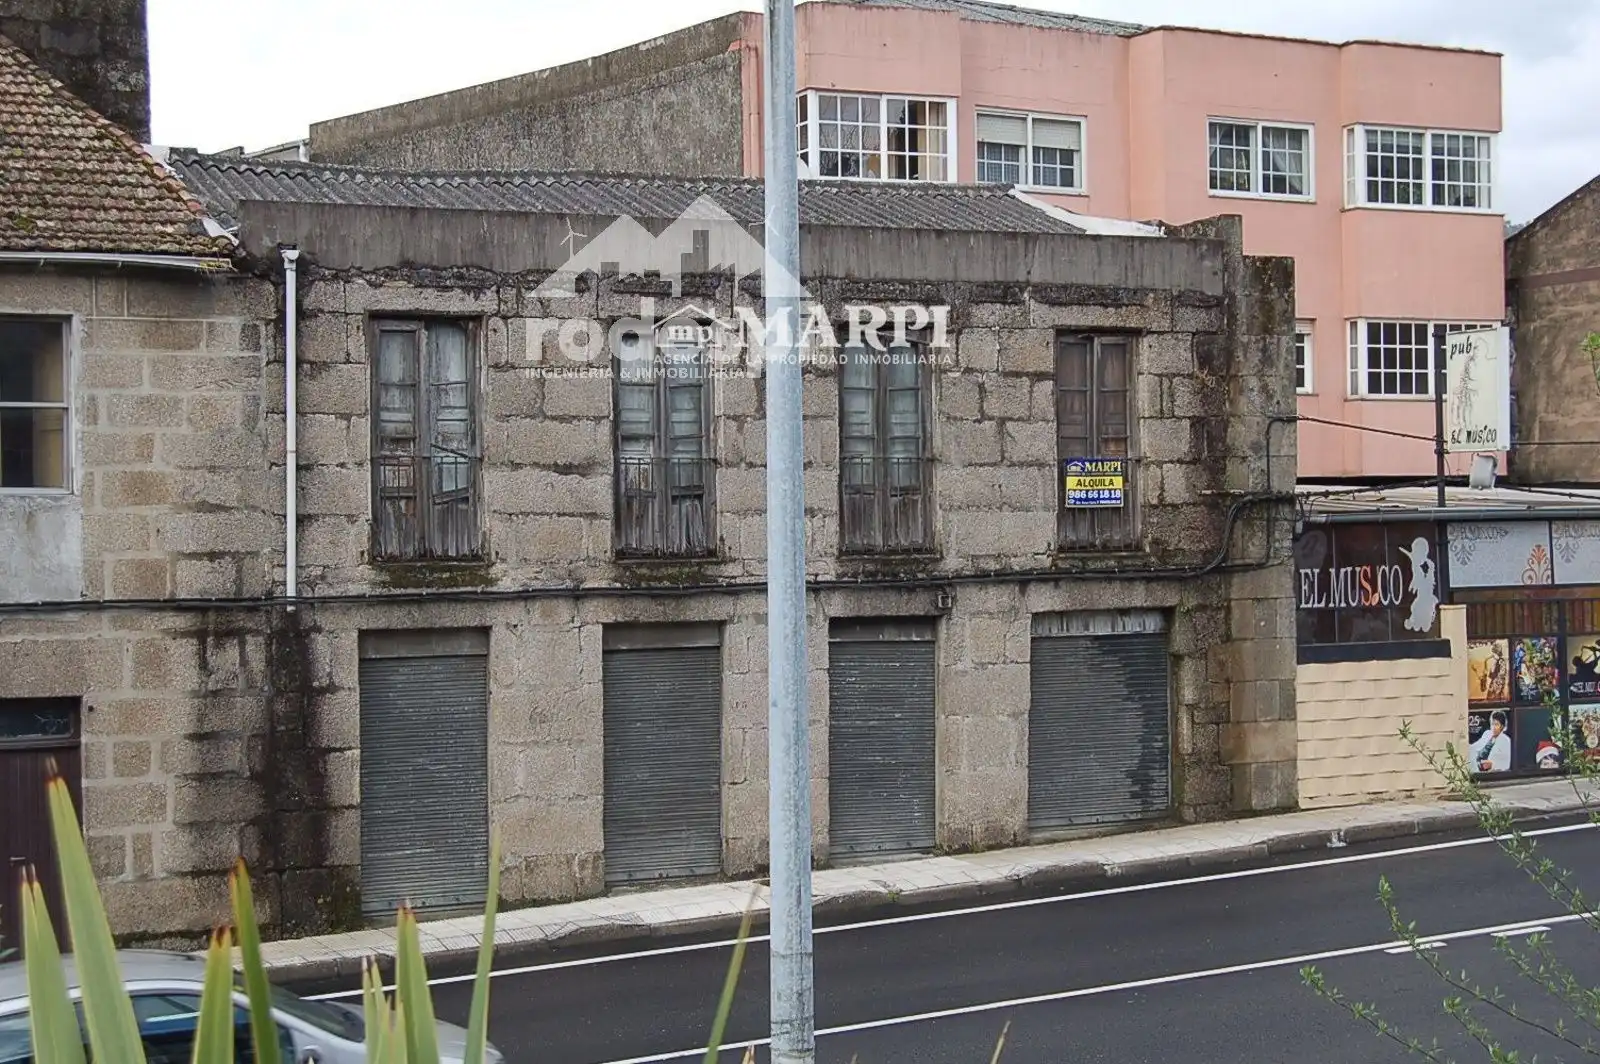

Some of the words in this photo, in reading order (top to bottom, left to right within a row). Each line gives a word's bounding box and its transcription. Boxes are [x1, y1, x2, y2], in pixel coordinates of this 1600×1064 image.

[1450, 335, 1472, 360] pub
[1084, 461, 1122, 472] MARPI
[1075, 479, 1115, 488] ALQUILA
[1068, 490, 1087, 499] 986
[1099, 490, 1109, 499] 18
[1111, 490, 1121, 499] 18
[1300, 567, 1327, 608] EL
